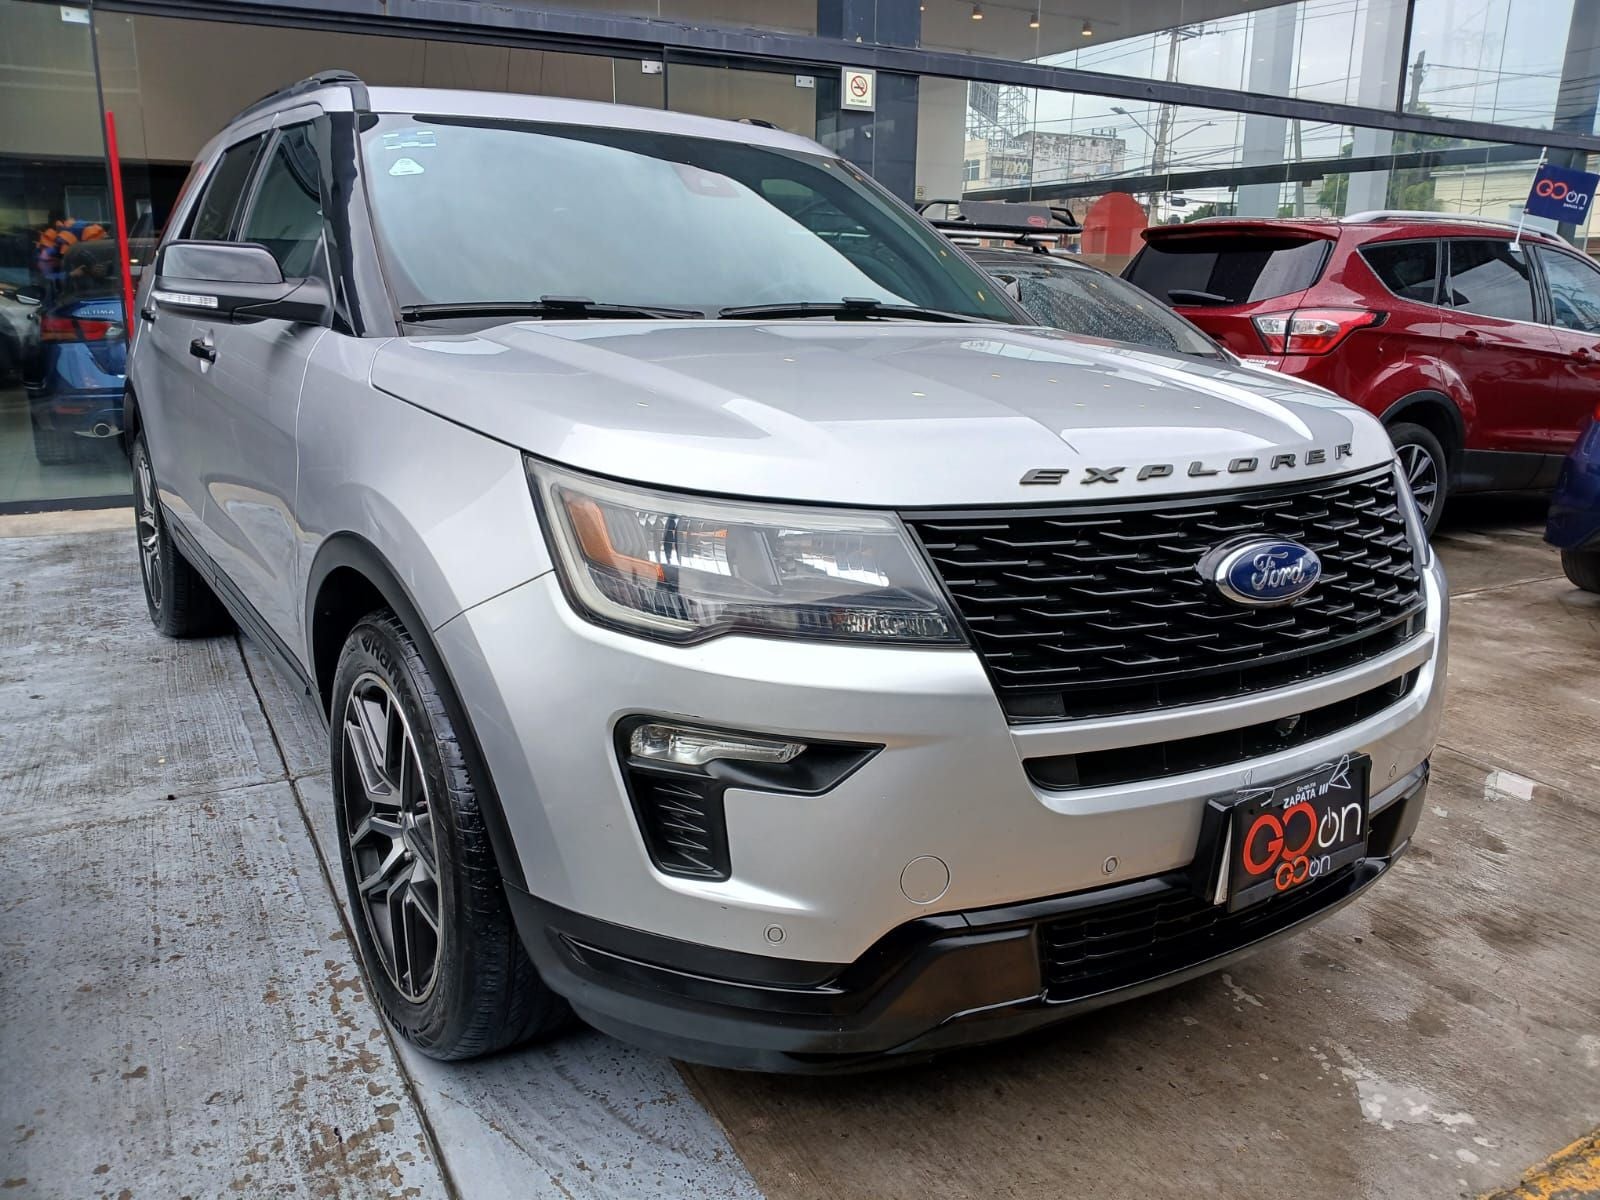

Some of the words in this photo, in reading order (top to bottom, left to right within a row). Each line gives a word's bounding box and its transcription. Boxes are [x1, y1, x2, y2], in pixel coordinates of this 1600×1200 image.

[1019, 442, 1353, 485] EXPLORER
[1251, 551, 1305, 591] Ford
[1283, 788, 1316, 809] ZAPATA
